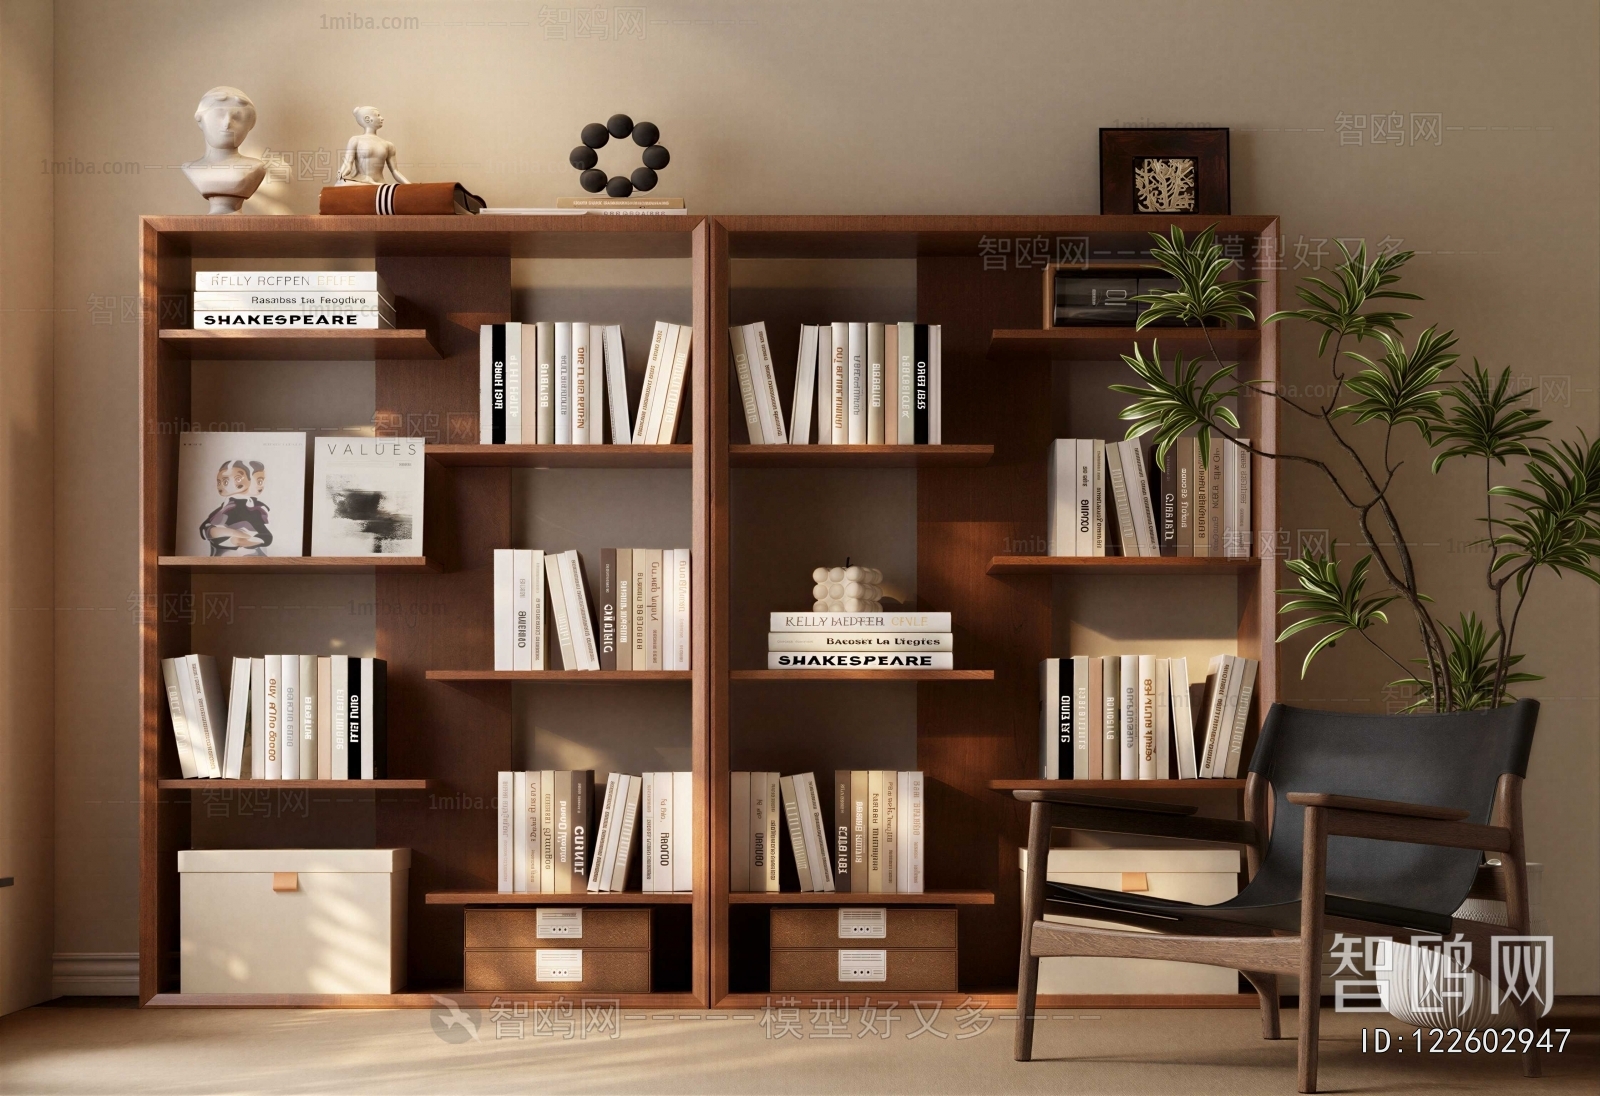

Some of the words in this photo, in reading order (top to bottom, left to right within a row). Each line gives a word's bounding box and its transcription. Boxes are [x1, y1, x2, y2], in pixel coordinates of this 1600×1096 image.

[204, 314, 357, 325] SHAKESPEARE
[327, 443, 417, 456] VALUES
[778, 655, 932, 666] SHAKESPEARE
